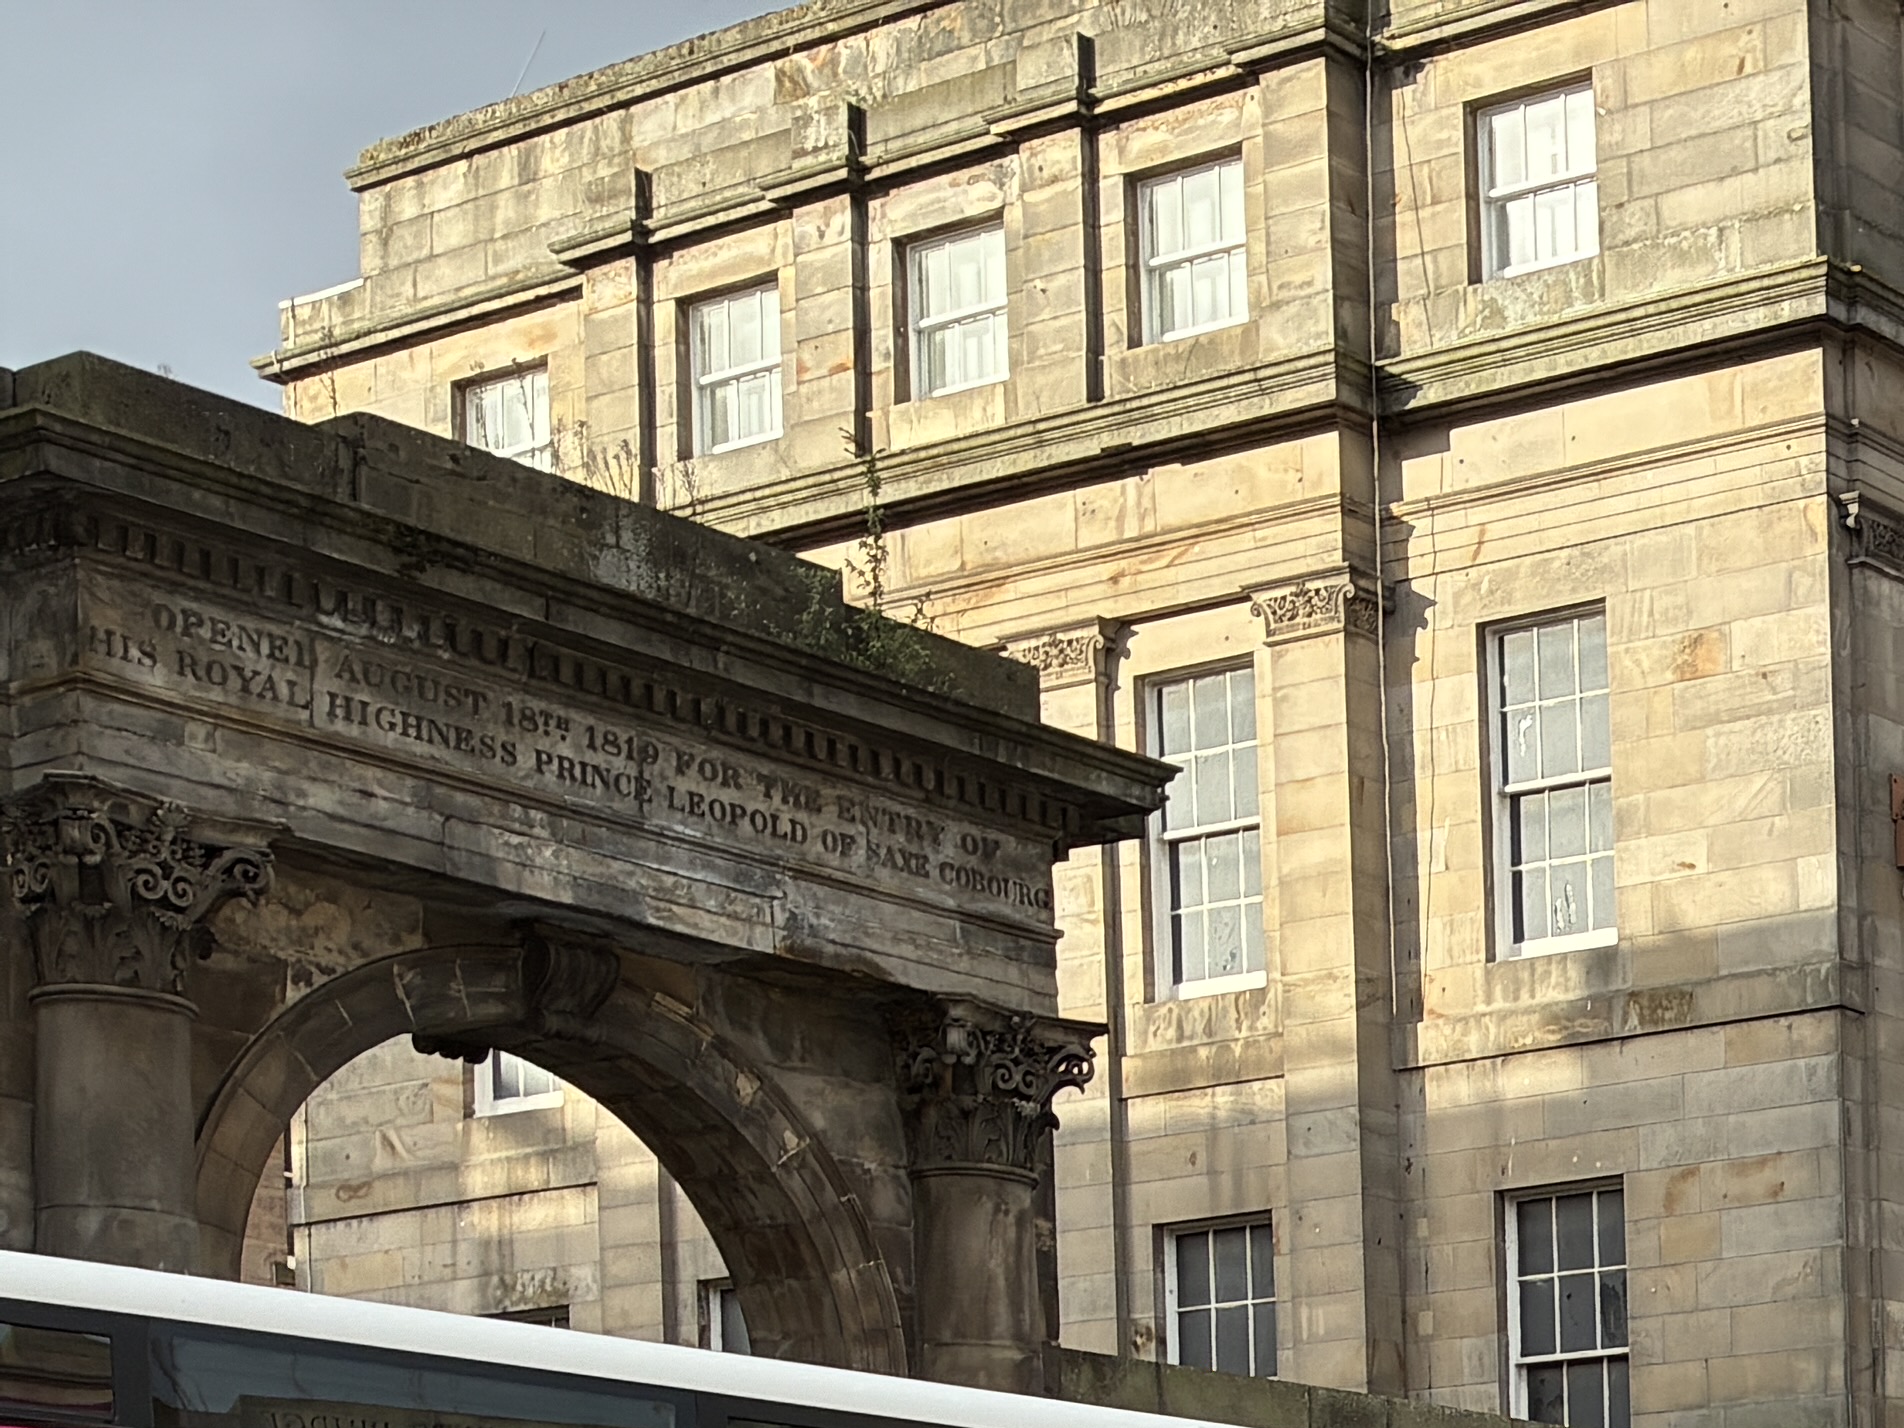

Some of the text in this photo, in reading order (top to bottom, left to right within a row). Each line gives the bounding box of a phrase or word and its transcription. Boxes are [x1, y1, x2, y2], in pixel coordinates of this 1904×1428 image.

[89, 626, 1052, 909] HIS ROYAL HIGHNESS PRINCE LEOPOLD OF SAXE COBOURG
[336, 649, 487, 714] AUGUST
[585, 725, 659, 765] 1819
[676, 750, 742, 790] FOR
[837, 795, 946, 848] ENTRY
